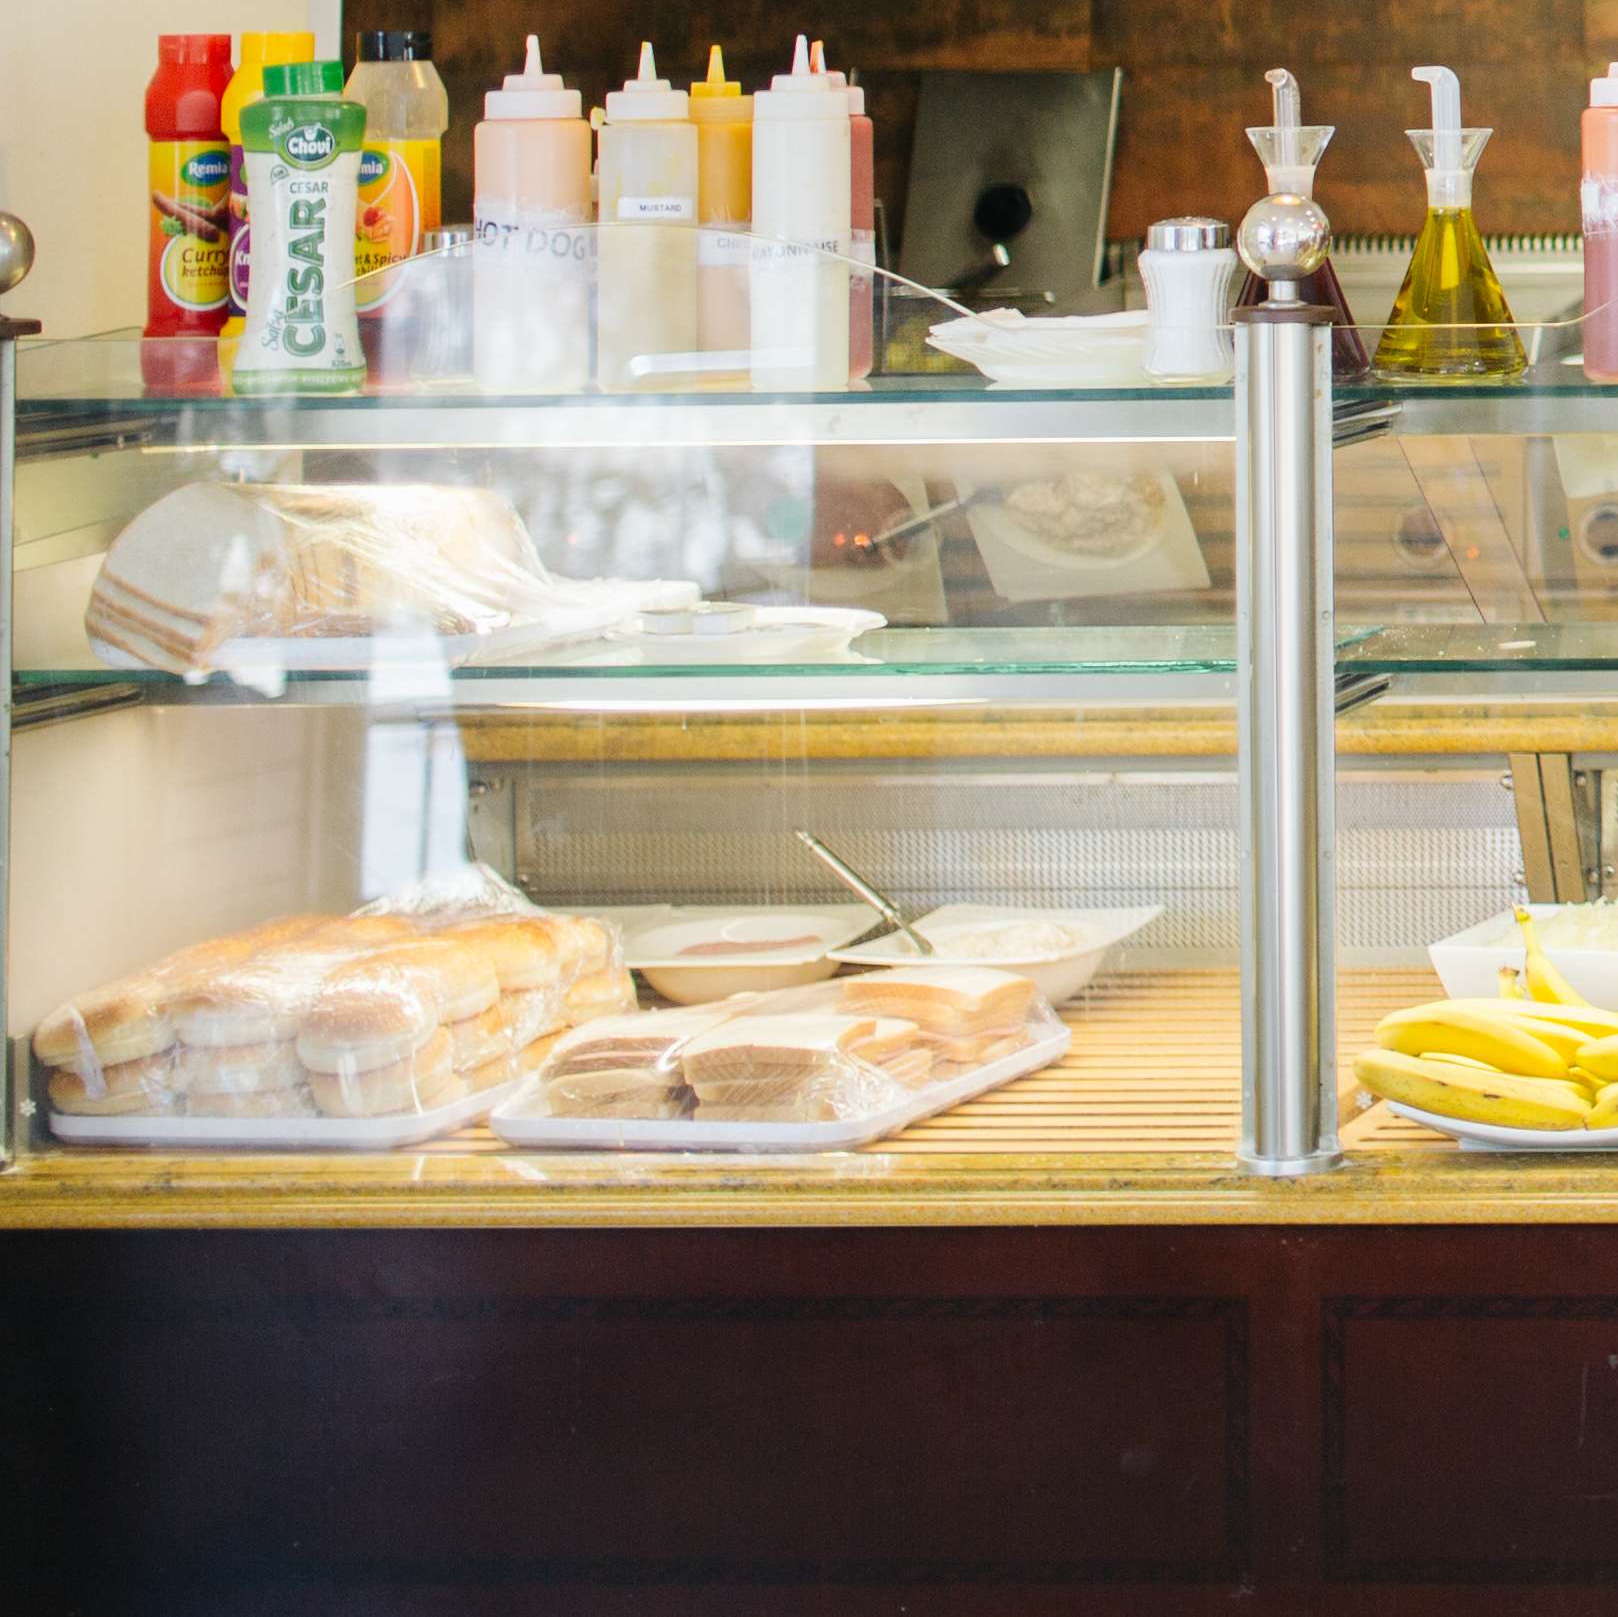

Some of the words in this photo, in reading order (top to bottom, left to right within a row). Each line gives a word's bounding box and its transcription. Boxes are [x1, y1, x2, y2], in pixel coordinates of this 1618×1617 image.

[188, 160, 228, 179] Remia
[289, 181, 329, 194] CESAR
[638, 203, 683, 213] MUSTARD
